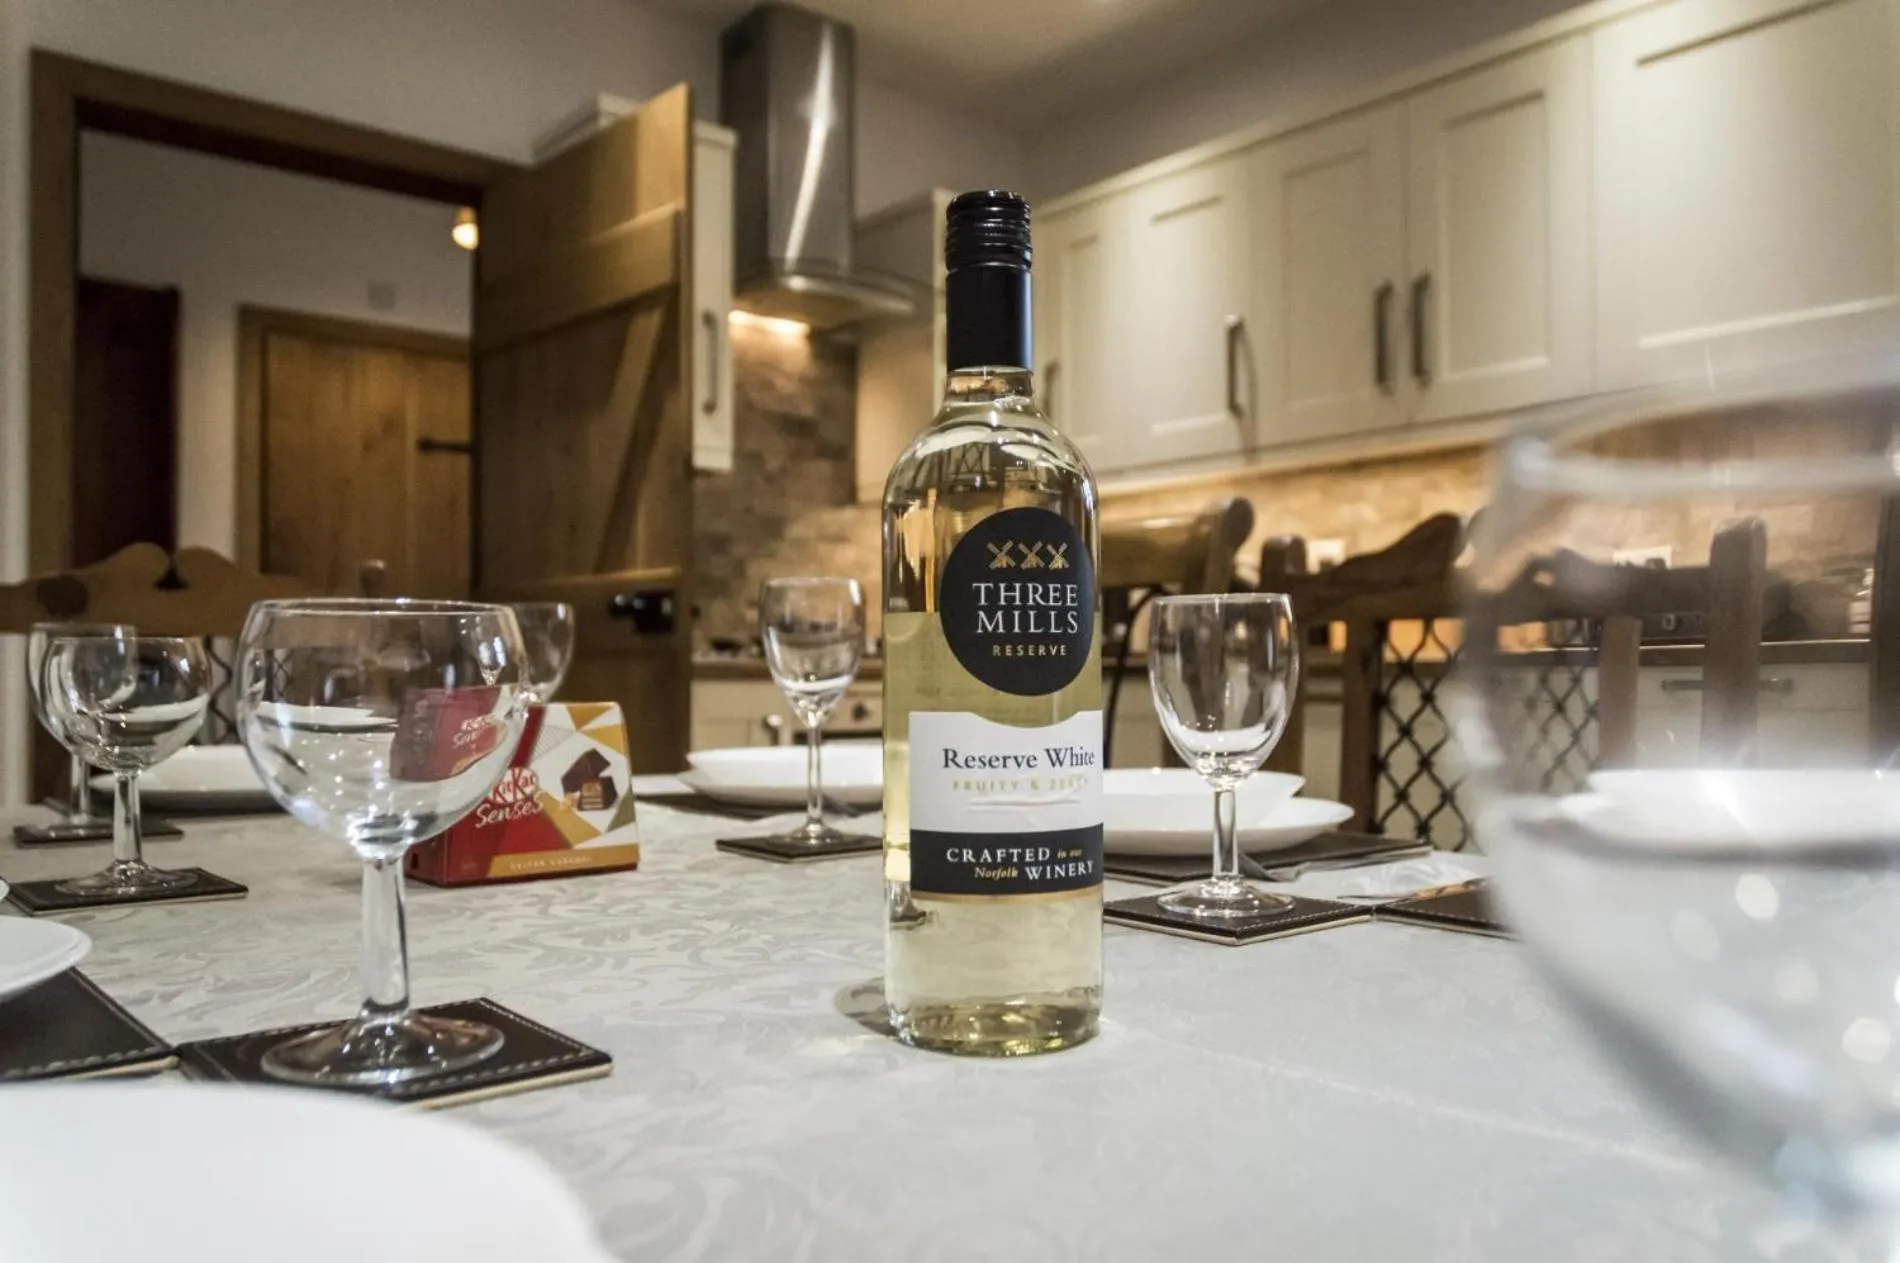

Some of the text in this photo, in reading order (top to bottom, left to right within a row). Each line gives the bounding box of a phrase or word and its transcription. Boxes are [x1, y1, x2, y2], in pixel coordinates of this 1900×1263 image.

[972, 582, 1079, 606] THREE
[975, 610, 1078, 634] MILLS
[992, 644, 1067, 657] RESERVE
[942, 746, 1096, 769] Reserve White
[952, 779, 1019, 792] FRUITY
[474, 798, 545, 829] Senses
[946, 847, 1051, 863] CRAFTED
[974, 860, 1094, 881] Norfolk WINERY
